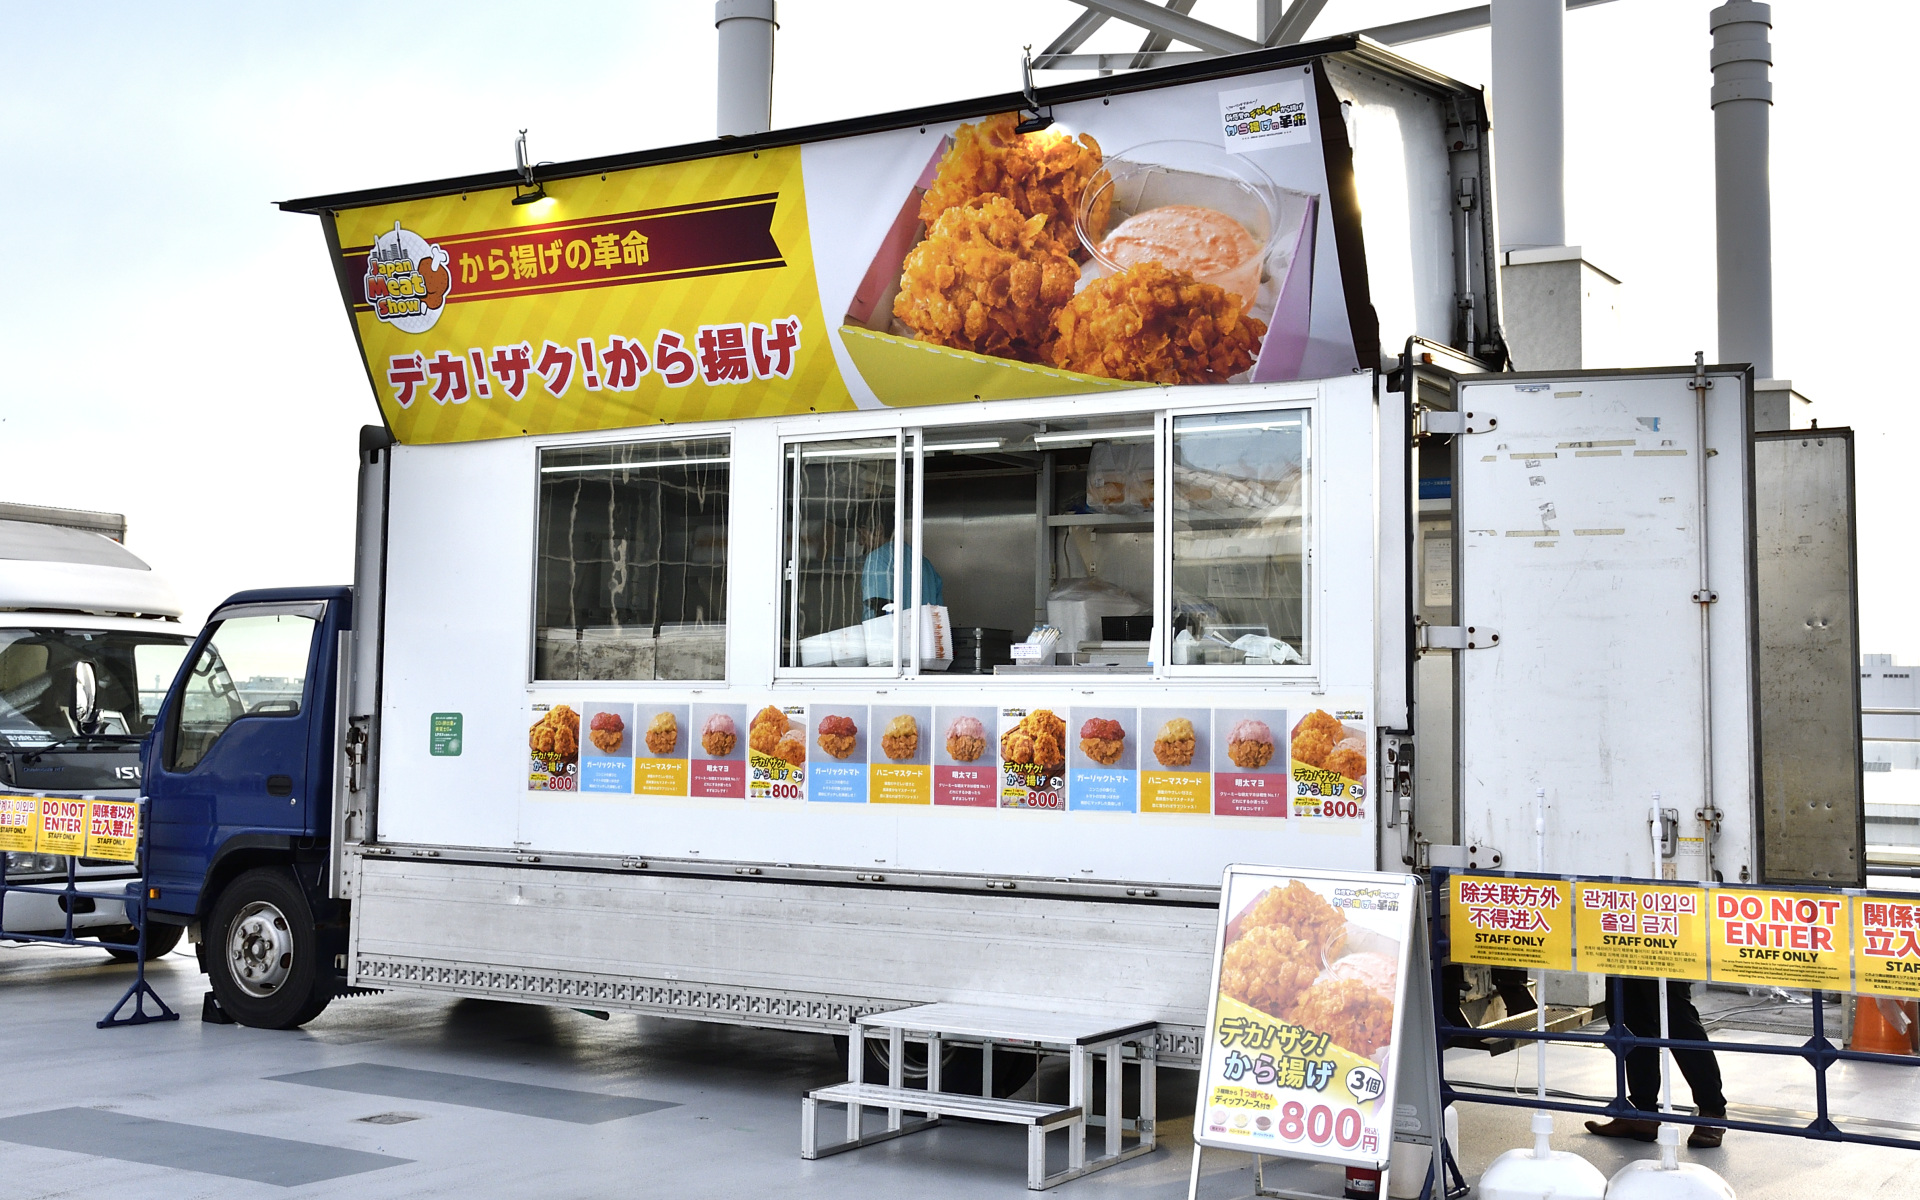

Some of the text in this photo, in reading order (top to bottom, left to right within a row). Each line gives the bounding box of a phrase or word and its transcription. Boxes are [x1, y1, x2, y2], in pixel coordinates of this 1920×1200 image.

[459, 230, 650, 284] から揚げの革命
[372, 259, 412, 277] Japan
[367, 273, 426, 298] Meat
[379, 299, 419, 316] Show
[389, 317, 800, 407] デカ!ザク!から揚げ
[640, 763, 682, 771] ハニーマスタード
[815, 768, 860, 776] ガーリックトマト
[876, 769, 924, 778] ハニーマスタード
[549, 777, 572, 790] 800
[1077, 774, 1129, 783] ガーリックトマト
[1148, 777, 1202, 786] ハニーマスタード
[772, 784, 798, 798] 800
[1297, 782, 1345, 796] から揚げ
[0, 800, 35, 812] 계자 이외의
[1028, 791, 1058, 807] 800
[43, 801, 85, 817] DO NOT
[92, 804, 135, 820] 関係者以外
[1323, 800, 1358, 817] 800
[0, 813, 28, 826] 출입 금지
[44, 817, 81, 833] ENTER
[91, 819, 134, 837] 立入禁止
[1460, 882, 1560, 908] 除关联方外
[1583, 890, 1695, 914] 관계자 이외의
[1717, 895, 1840, 925] DO NOT
[1863, 903, 1920, 929] 関係
[1469, 907, 1550, 932] 不得进入
[1601, 912, 1678, 936] 출입 금지
[1475, 933, 1545, 947] STAFF ONLY
[1603, 935, 1677, 949] STAFF ONLY
[1726, 921, 1834, 951] ENTER
[1739, 948, 1819, 963] STAFF ONLY
[1219, 1017, 1331, 1056] デカ!ザク!
[1223, 1051, 1336, 1090] から揚げ
[1350, 1070, 1382, 1094] 3個
[1214, 1095, 1271, 1110] ディップソース付き
[1279, 1101, 1362, 1147] 800
[1362, 1135, 1378, 1152] 円
